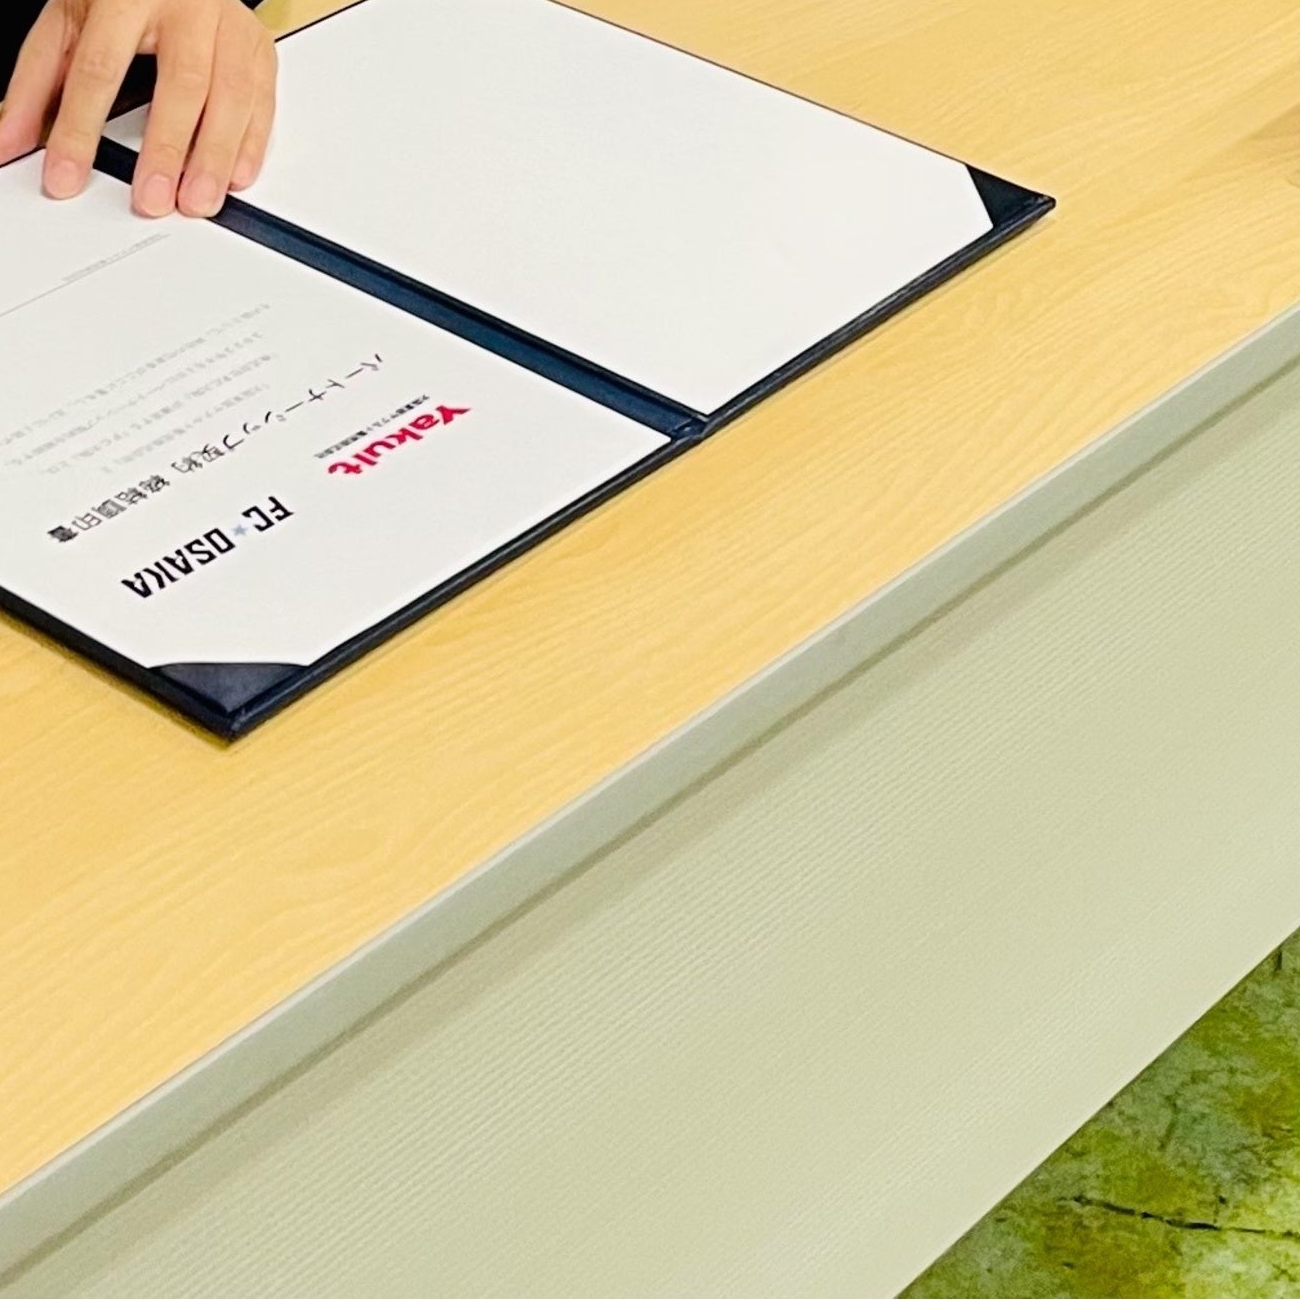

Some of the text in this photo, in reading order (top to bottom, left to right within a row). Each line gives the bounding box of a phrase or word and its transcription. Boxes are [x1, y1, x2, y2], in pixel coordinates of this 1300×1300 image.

[171, 353, 383, 474] パートナーシップ契約
[327, 404, 471, 476] Yakult
[121, 495, 295, 599] FC OSAKA
